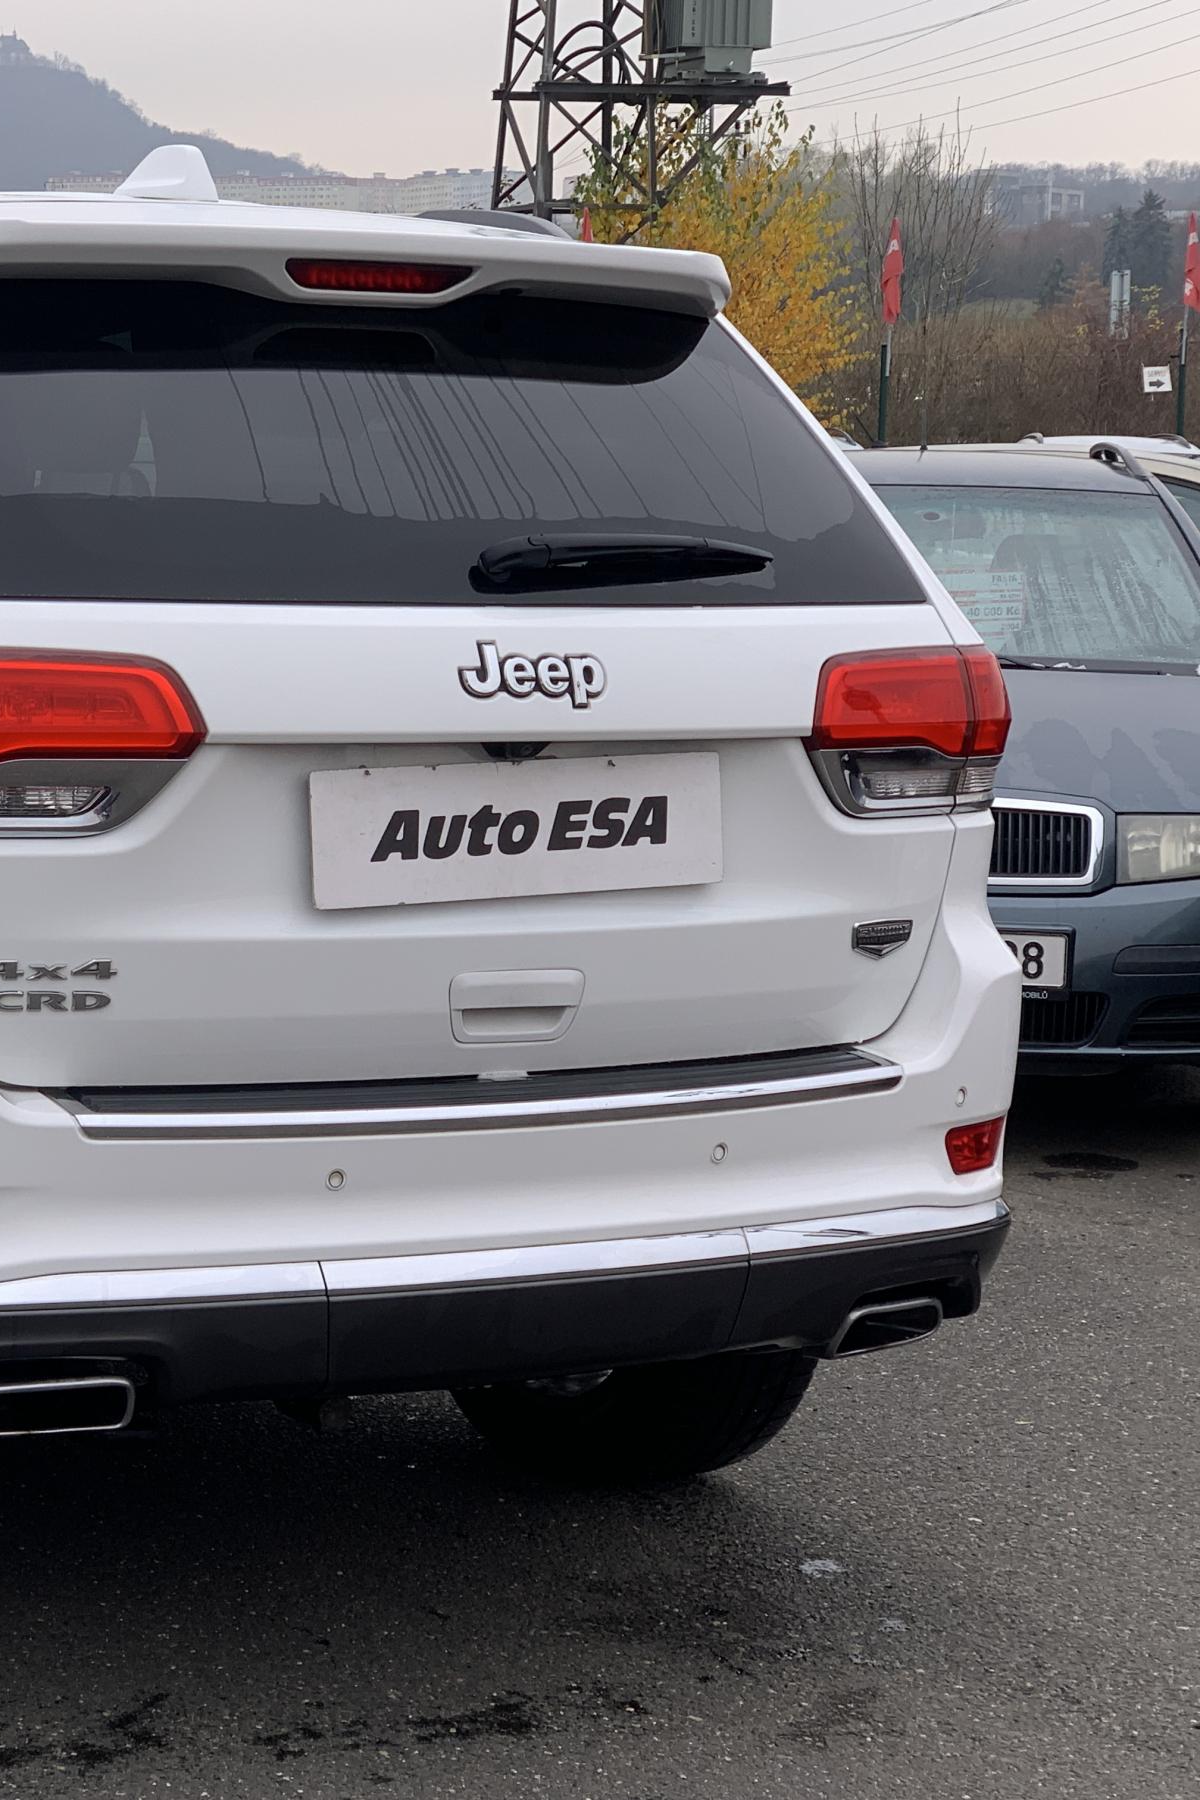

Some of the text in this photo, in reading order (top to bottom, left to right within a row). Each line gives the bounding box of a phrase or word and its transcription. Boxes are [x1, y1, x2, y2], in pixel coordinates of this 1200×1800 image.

[458, 640, 606, 709] Jeep
[370, 795, 668, 862] Auto ESA
